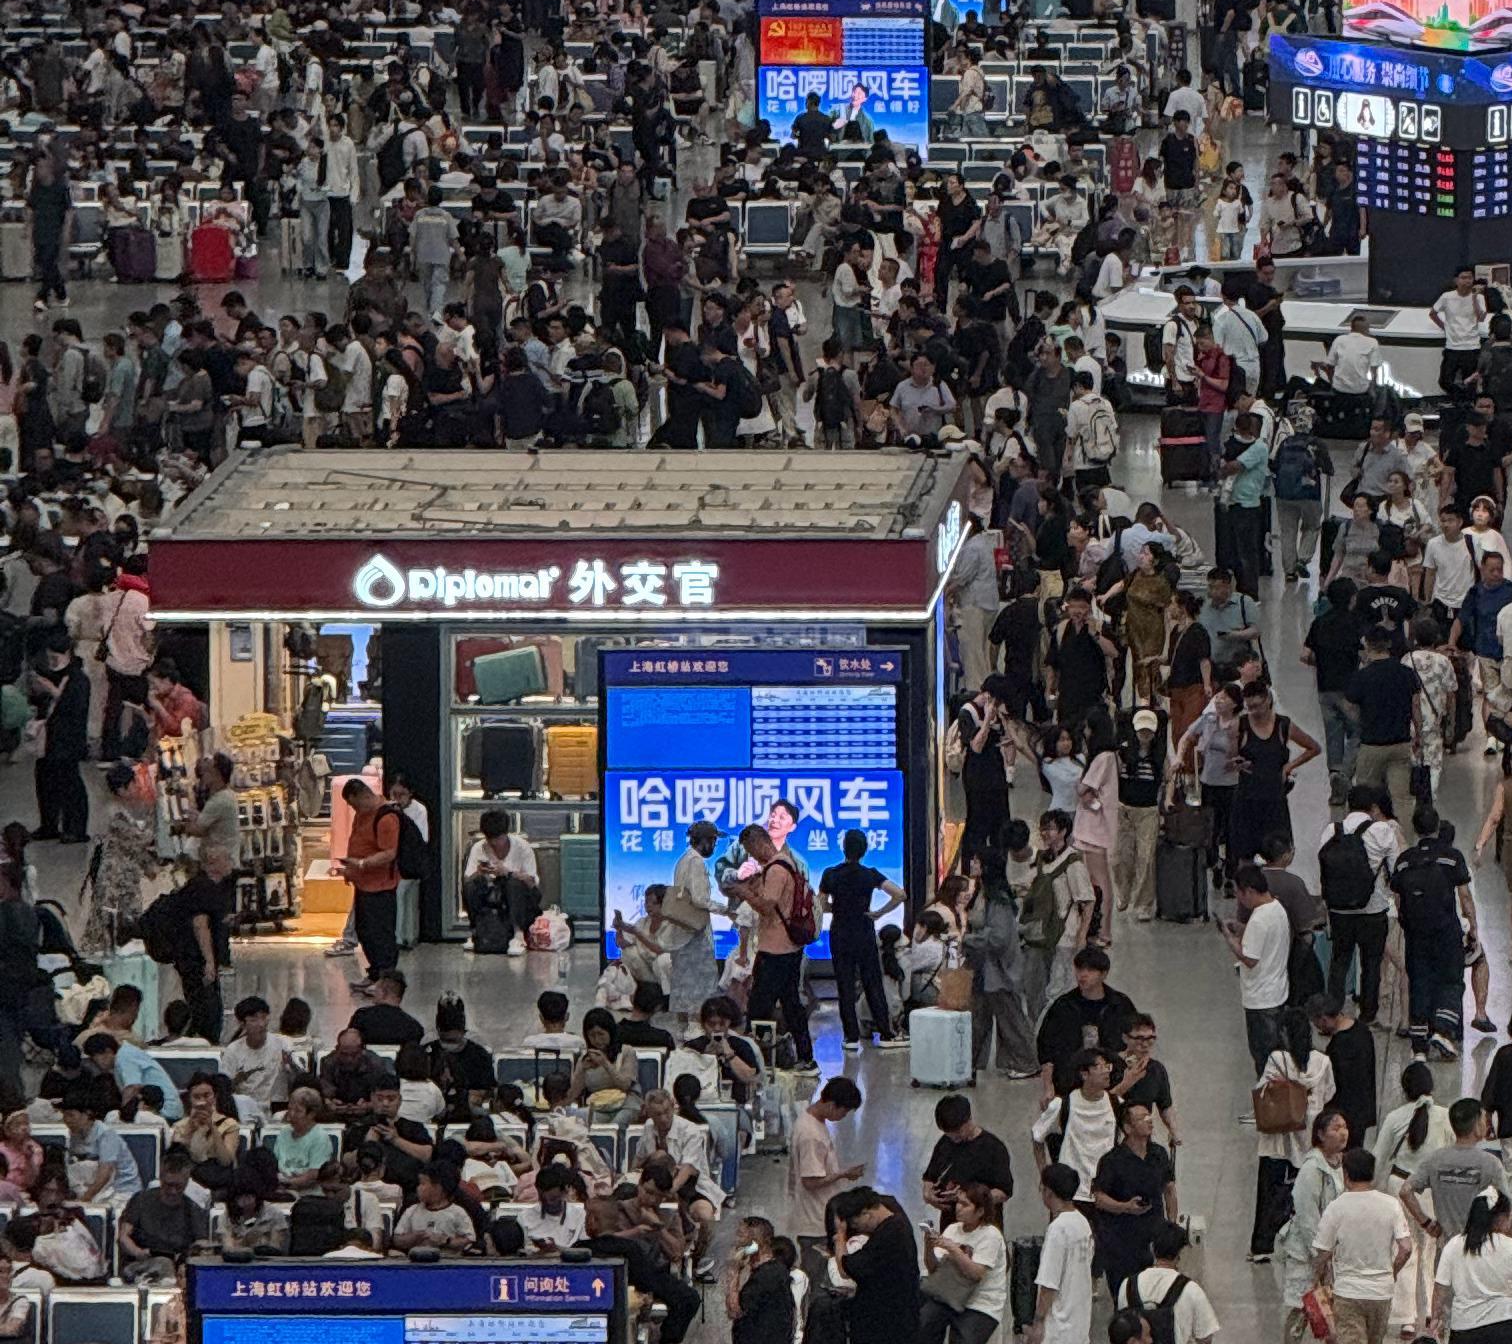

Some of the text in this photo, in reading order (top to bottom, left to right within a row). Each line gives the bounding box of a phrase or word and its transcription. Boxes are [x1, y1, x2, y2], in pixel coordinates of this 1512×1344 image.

[766, 69, 921, 100] 哈啰顺风车
[407, 557, 720, 606] Diplomat 外交官
[628, 660, 729, 673] 上海虹桥站欢迎您
[619, 776, 890, 829] 哈啰顺风车
[231, 1280, 372, 1298] 上海虹桥站欢迎您
[523, 1276, 571, 1293] 问询处
